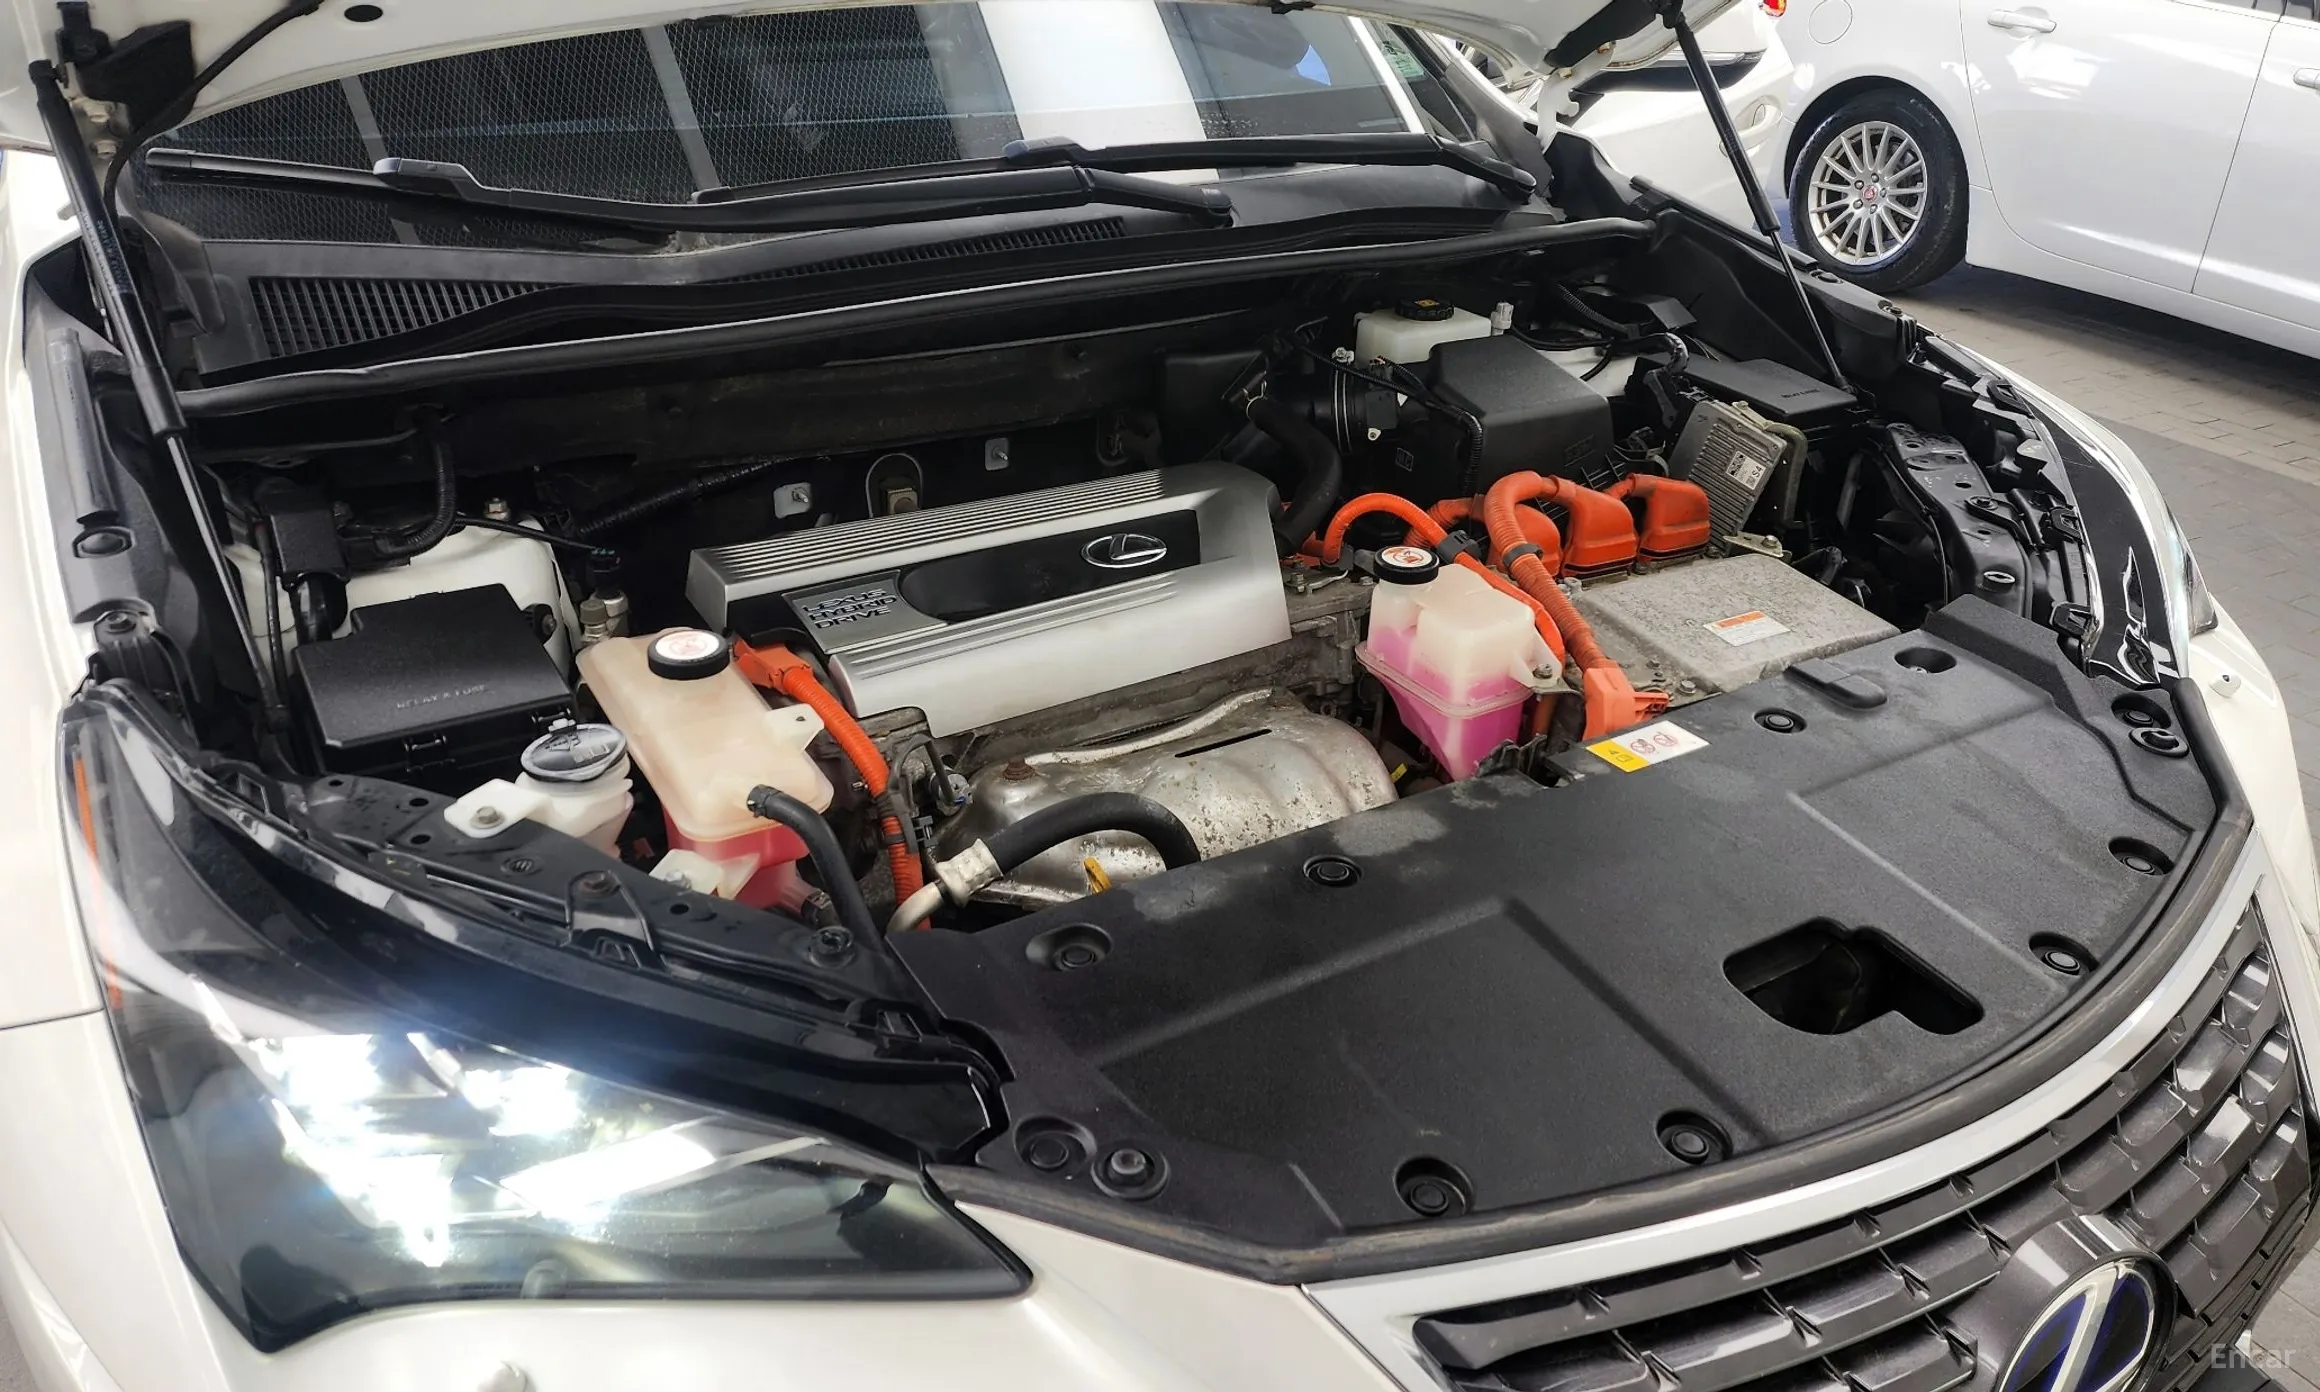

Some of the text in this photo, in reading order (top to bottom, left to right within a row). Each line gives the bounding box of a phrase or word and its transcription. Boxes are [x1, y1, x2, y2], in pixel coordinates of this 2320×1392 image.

[802, 588, 887, 612] LEXUS
[807, 595, 898, 620] HYBRID
[814, 606, 892, 629] DRIVE
